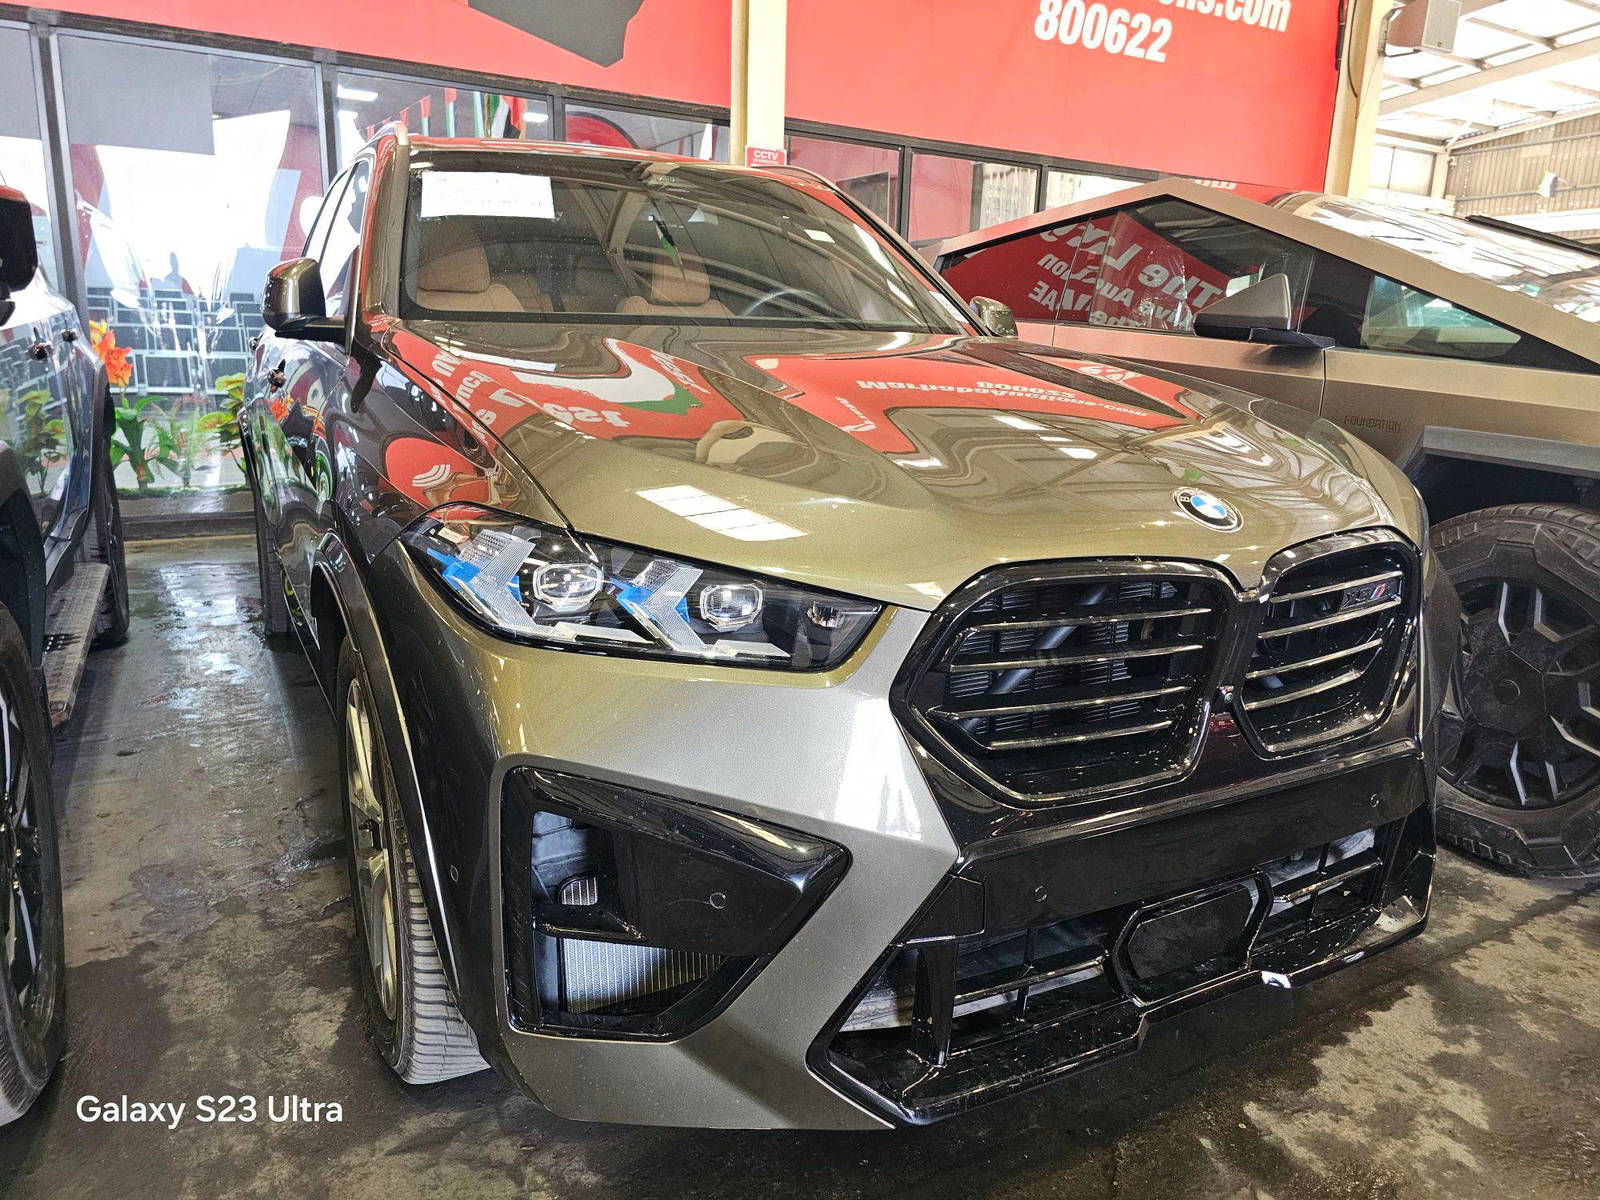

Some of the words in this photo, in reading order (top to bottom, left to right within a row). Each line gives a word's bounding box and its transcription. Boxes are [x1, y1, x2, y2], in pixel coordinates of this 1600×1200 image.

[1034, 0, 1173, 63] 800622
[753, 150, 778, 161] CCTV
[1344, 415, 1402, 432] FOUNDATION
